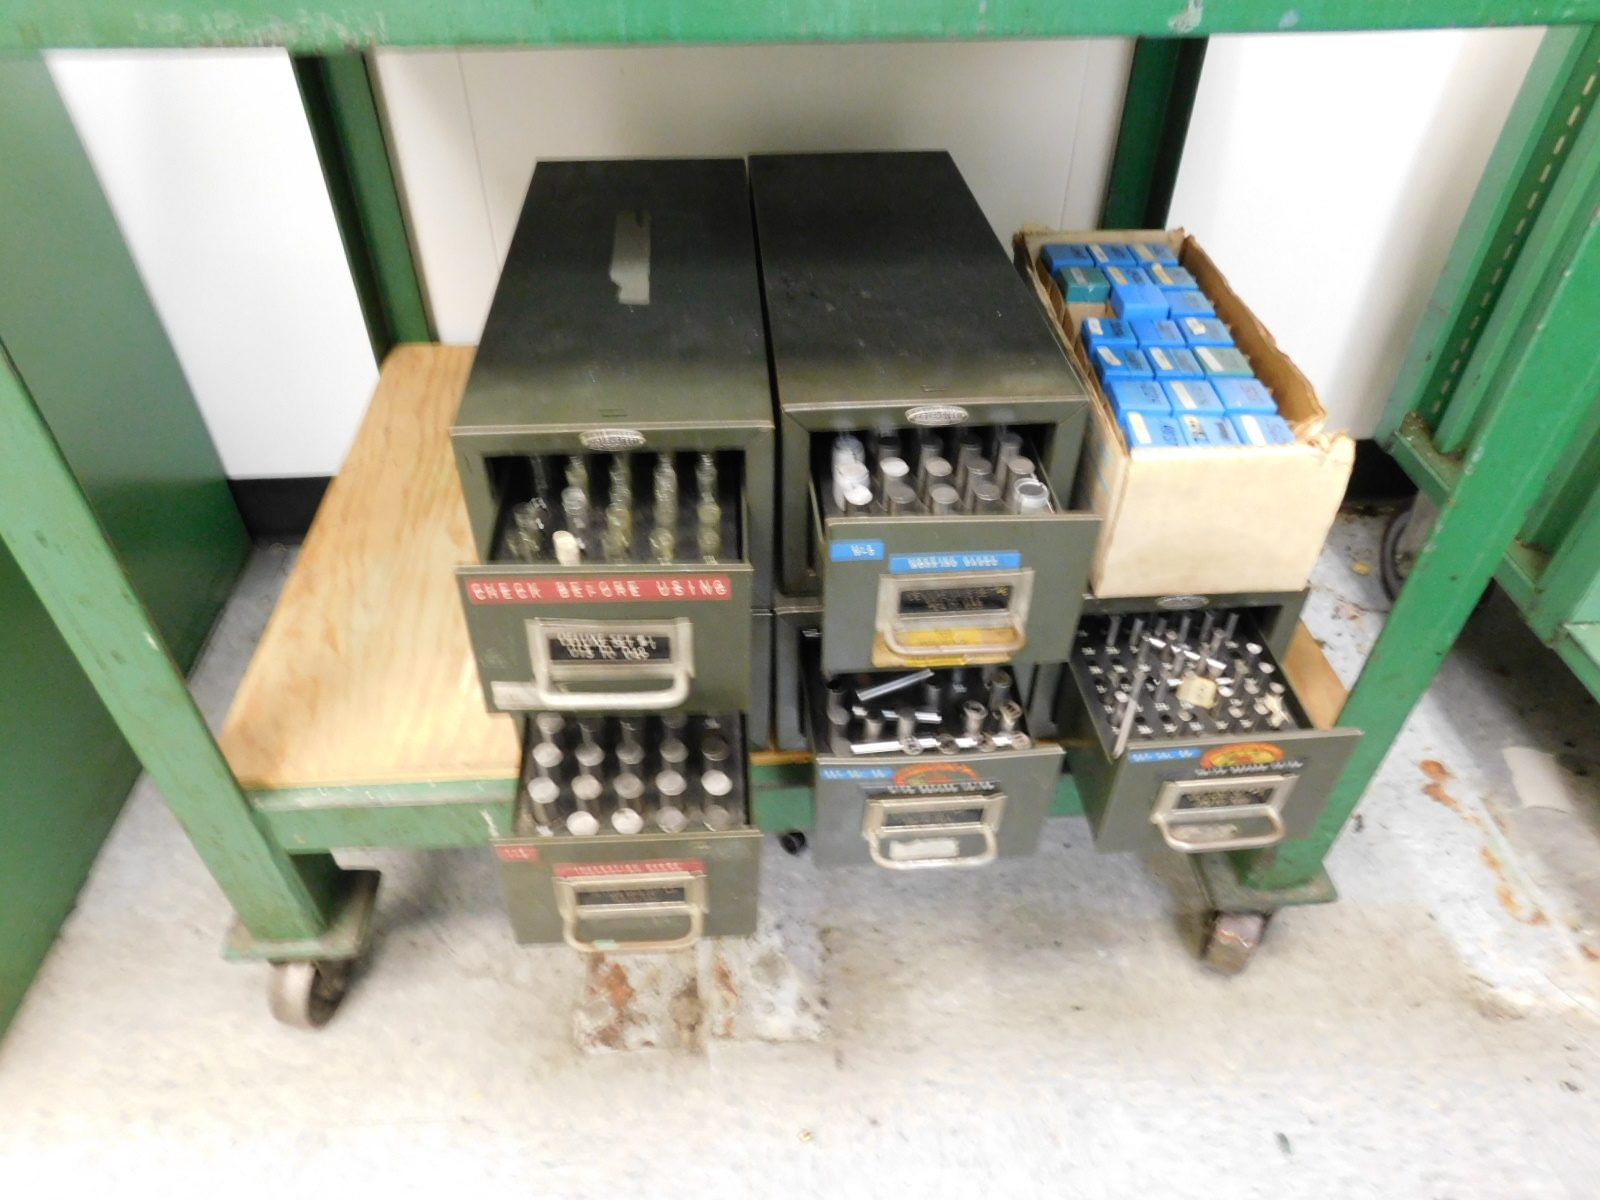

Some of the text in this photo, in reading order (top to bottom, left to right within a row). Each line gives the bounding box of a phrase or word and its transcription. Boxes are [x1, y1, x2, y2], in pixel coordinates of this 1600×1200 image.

[470, 578, 728, 601] CHECK BEFORE USING
